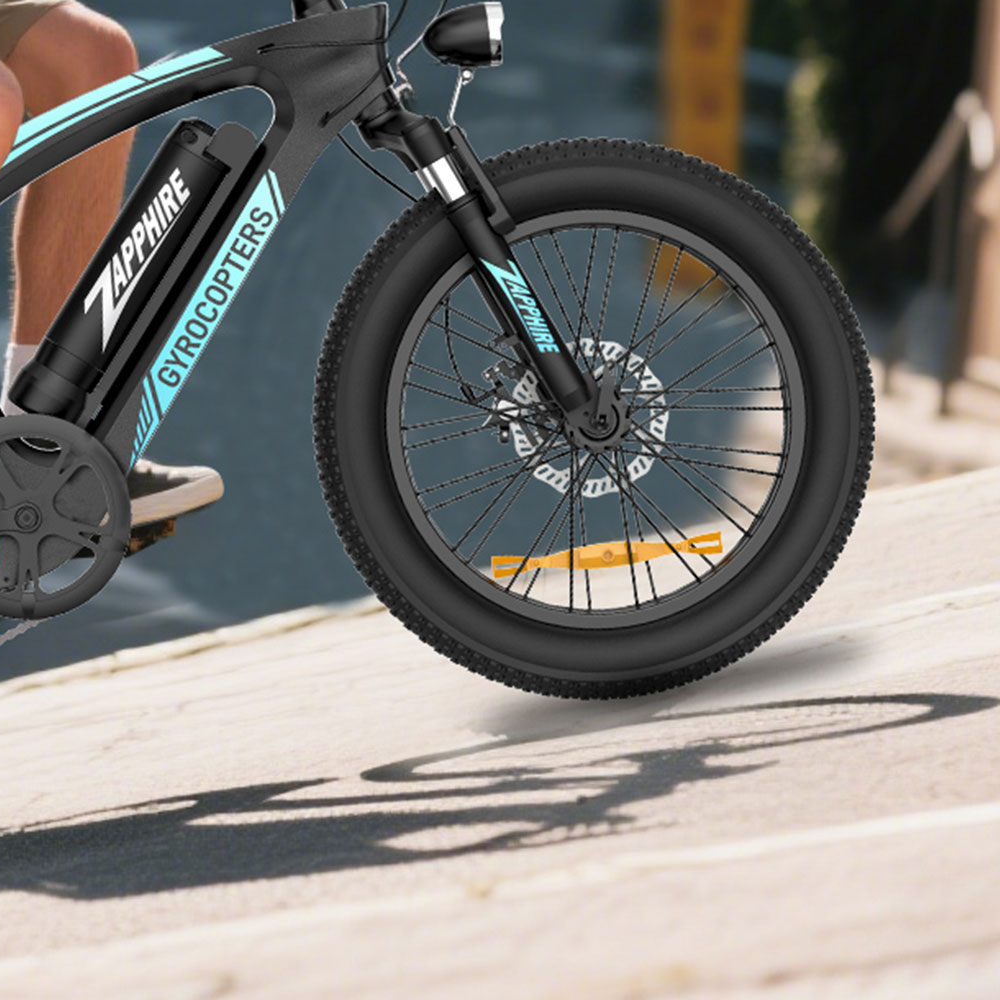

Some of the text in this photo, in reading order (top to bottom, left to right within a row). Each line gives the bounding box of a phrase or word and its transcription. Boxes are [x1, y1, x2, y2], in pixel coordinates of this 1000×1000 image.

[83, 167, 191, 352] ZAPPHIRE
[157, 206, 273, 388] GYROCOPTERS
[478, 257, 560, 353] ZAPPHIRE
